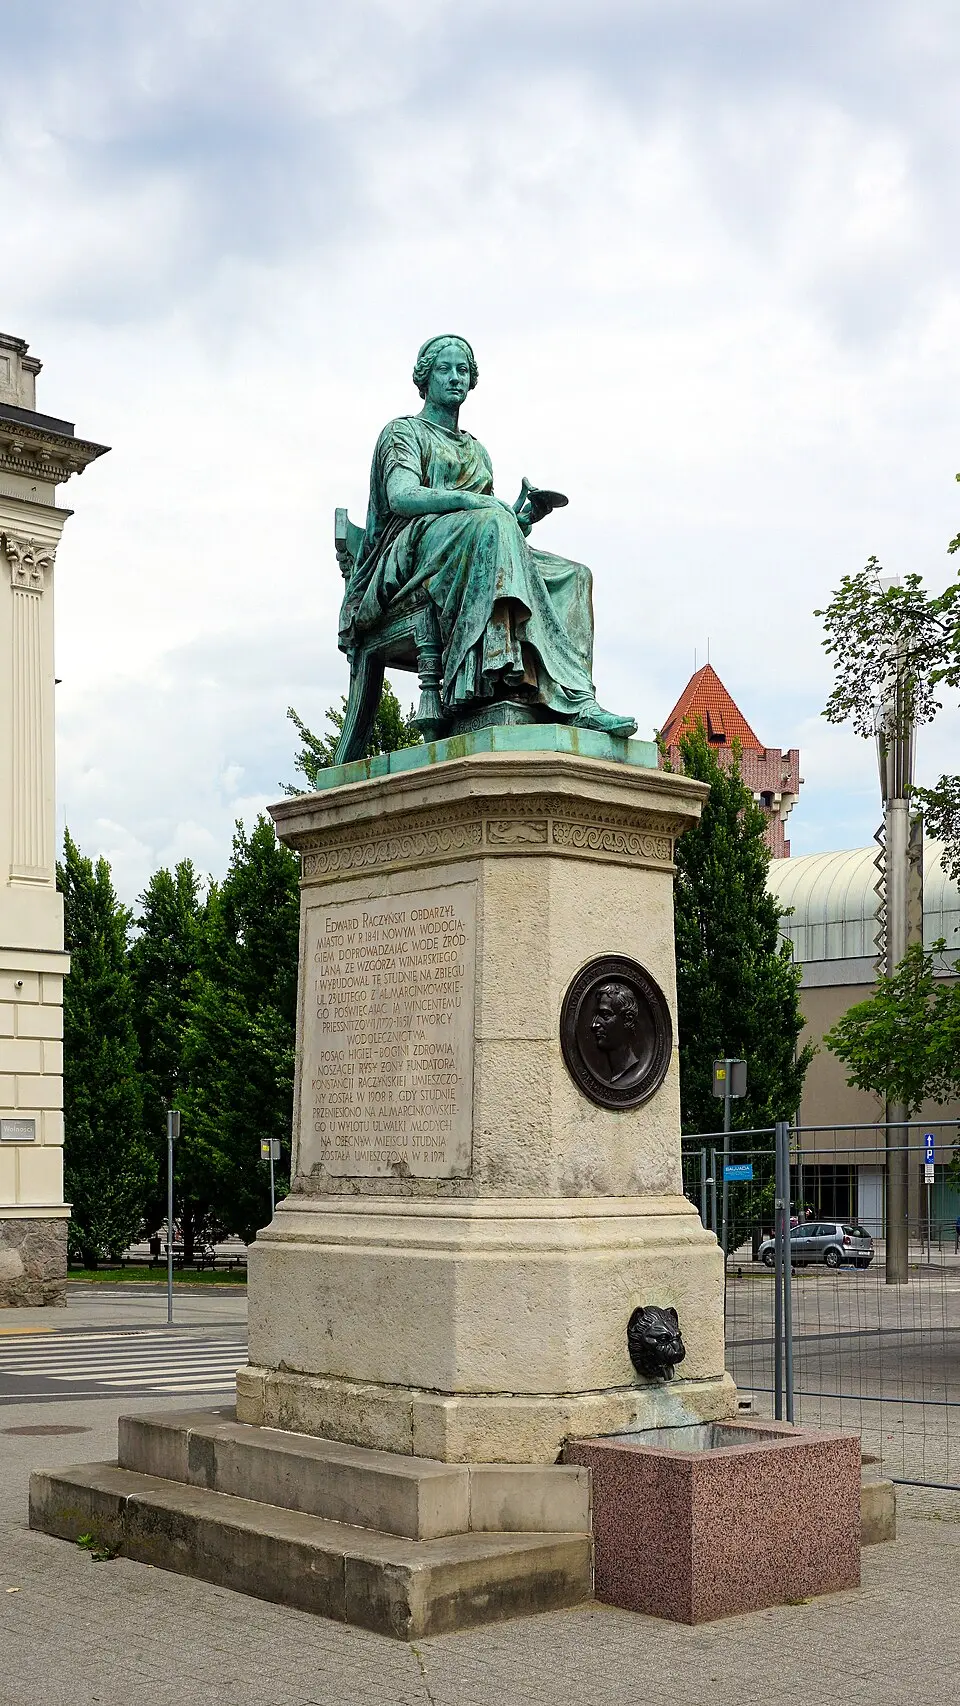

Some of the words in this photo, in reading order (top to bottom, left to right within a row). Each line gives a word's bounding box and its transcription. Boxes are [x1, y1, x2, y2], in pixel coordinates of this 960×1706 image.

[410, 905, 456, 921] OBDARZYŁ
[315, 934, 344, 950] MIASTO
[347, 933, 355, 944] W
[382, 926, 416, 941] NOWYM
[314, 951, 335, 963] GIEM
[412, 937, 439, 950] WODĘ
[345, 962, 355, 973] ZE
[399, 950, 458, 967] WINIARSKIEGO
[420, 969, 431, 981] NA
[434, 965, 465, 980] ZBIEGU
[370, 989, 376, 1000] Z
[316, 1008, 330, 1019] GO
[404, 997, 462, 1012] WINCENTEMU
[379, 1045, 409, 1058] BOGINI
[356, 1091, 366, 1102] W
[368, 1090, 386, 1103] 1908
[398, 1090, 417, 1101] GDY
[312, 1106, 362, 1119] PRZENIESIONO
[365, 1106, 376, 1118] NA
[314, 1121, 327, 1132] GO
[329, 1121, 336, 1132] U
[320, 1136, 331, 1147] NA
[412, 1135, 447, 1147] STUDNIA
[354, 1150, 408, 1162] UMIESZCZONA
[412, 1150, 421, 1161] W
